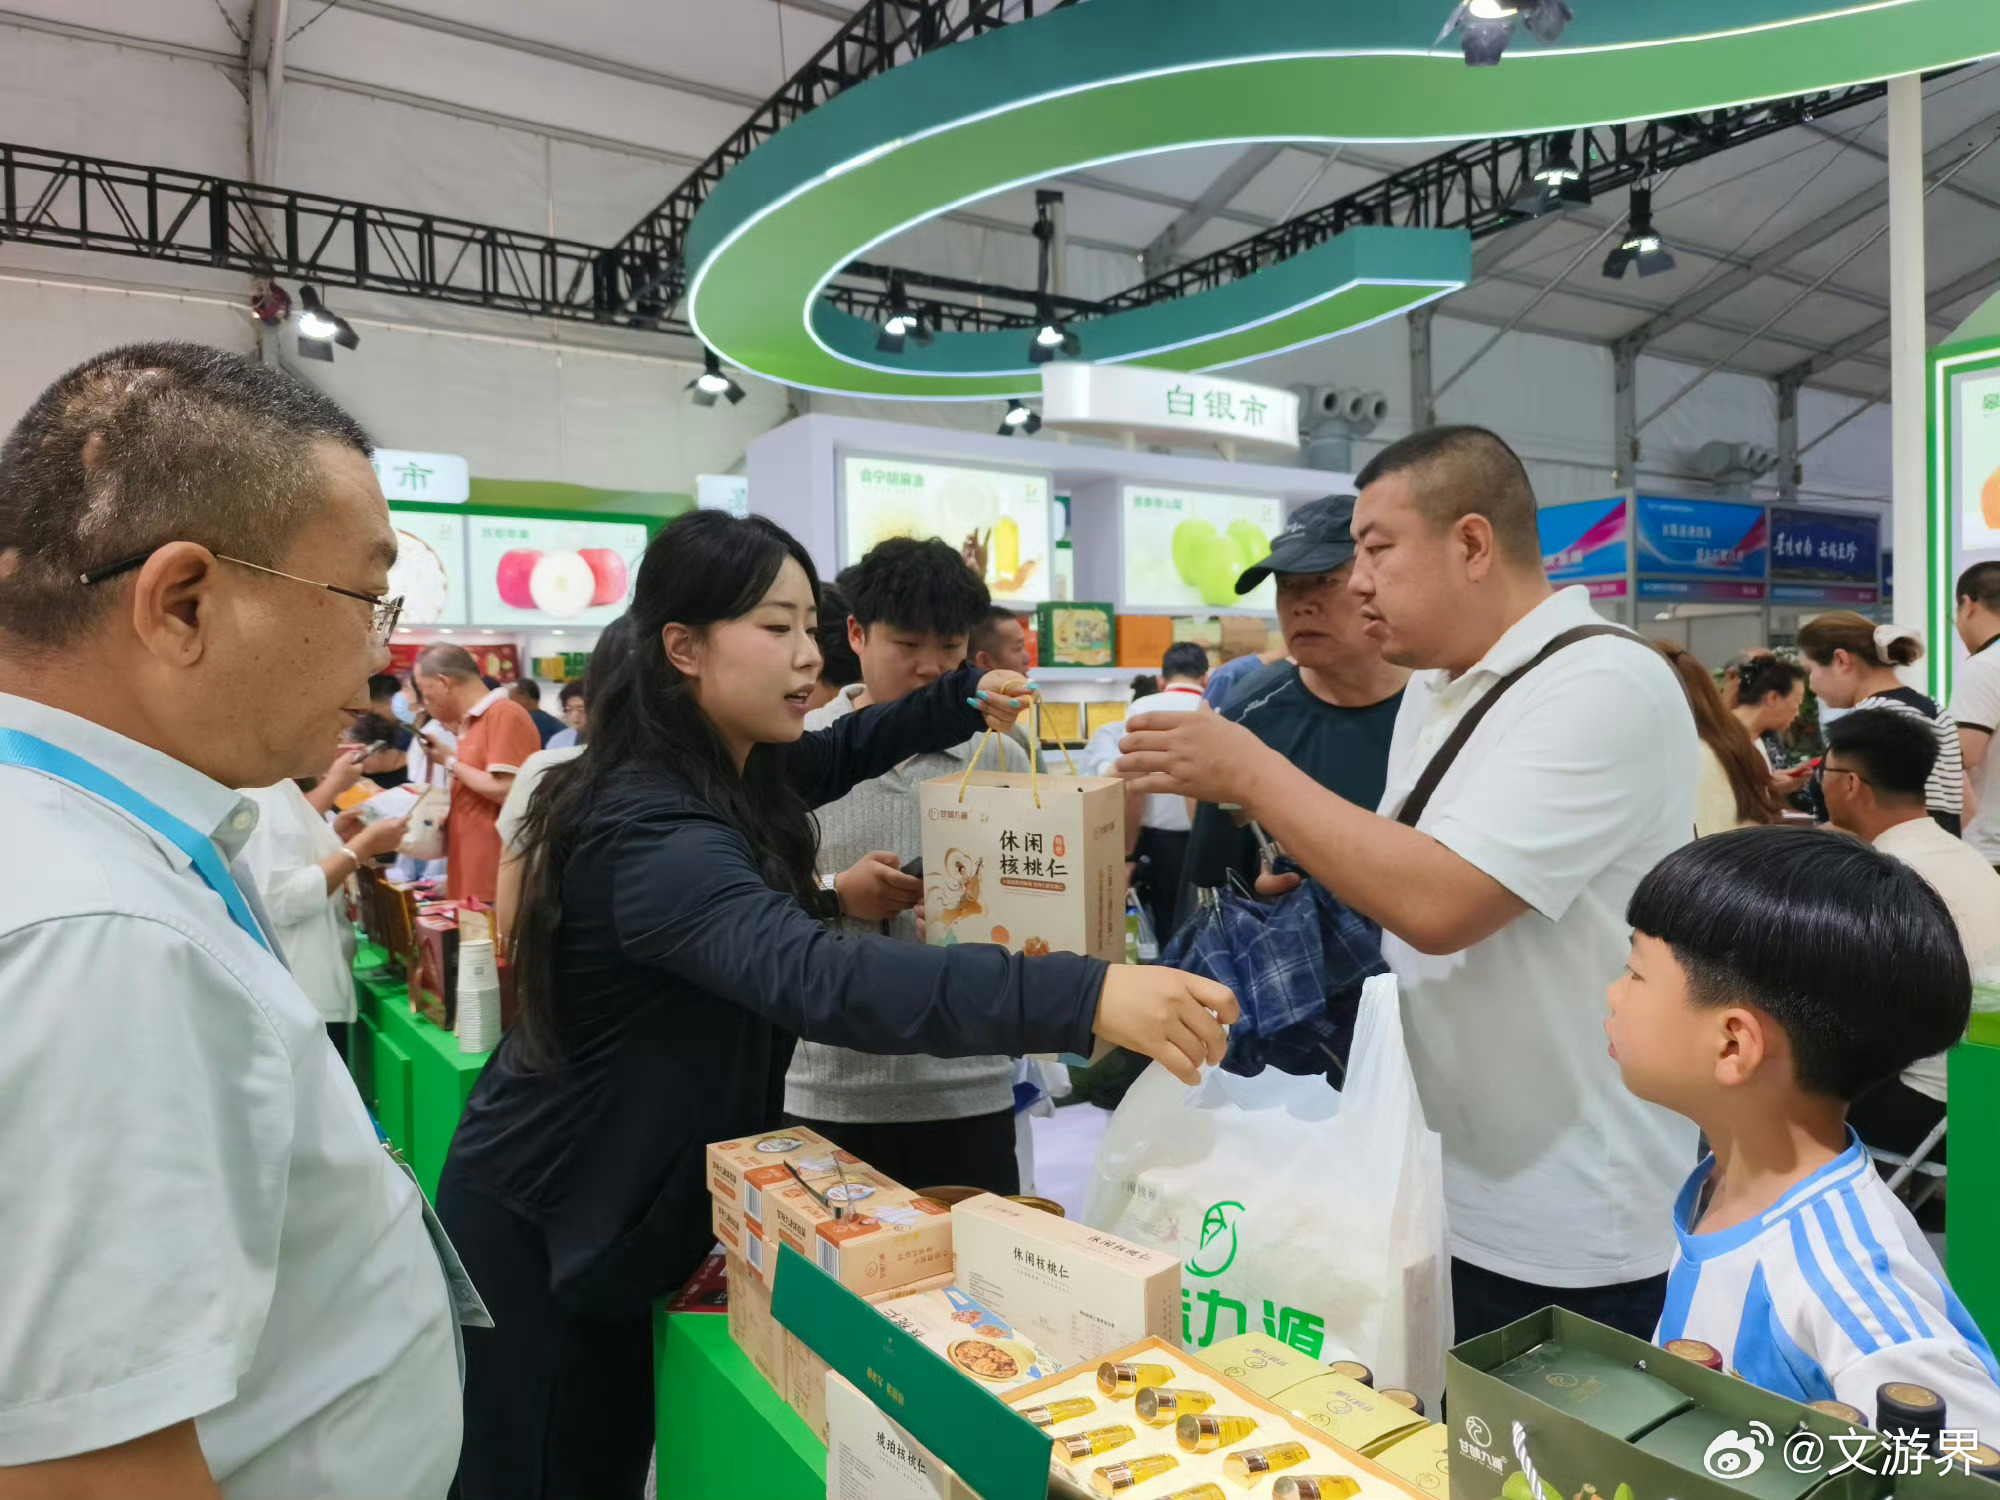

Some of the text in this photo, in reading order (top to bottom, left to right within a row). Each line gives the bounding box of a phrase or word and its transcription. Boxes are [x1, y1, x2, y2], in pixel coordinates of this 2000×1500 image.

[1166, 384, 1268, 427] 白银市
[999, 829, 1043, 854] 休闲
[999, 853, 1068, 878] 核桃仁
[1012, 1246, 1070, 1279] 休闲核桃仁
[876, 1431, 927, 1475] 琥珀核桃仁
